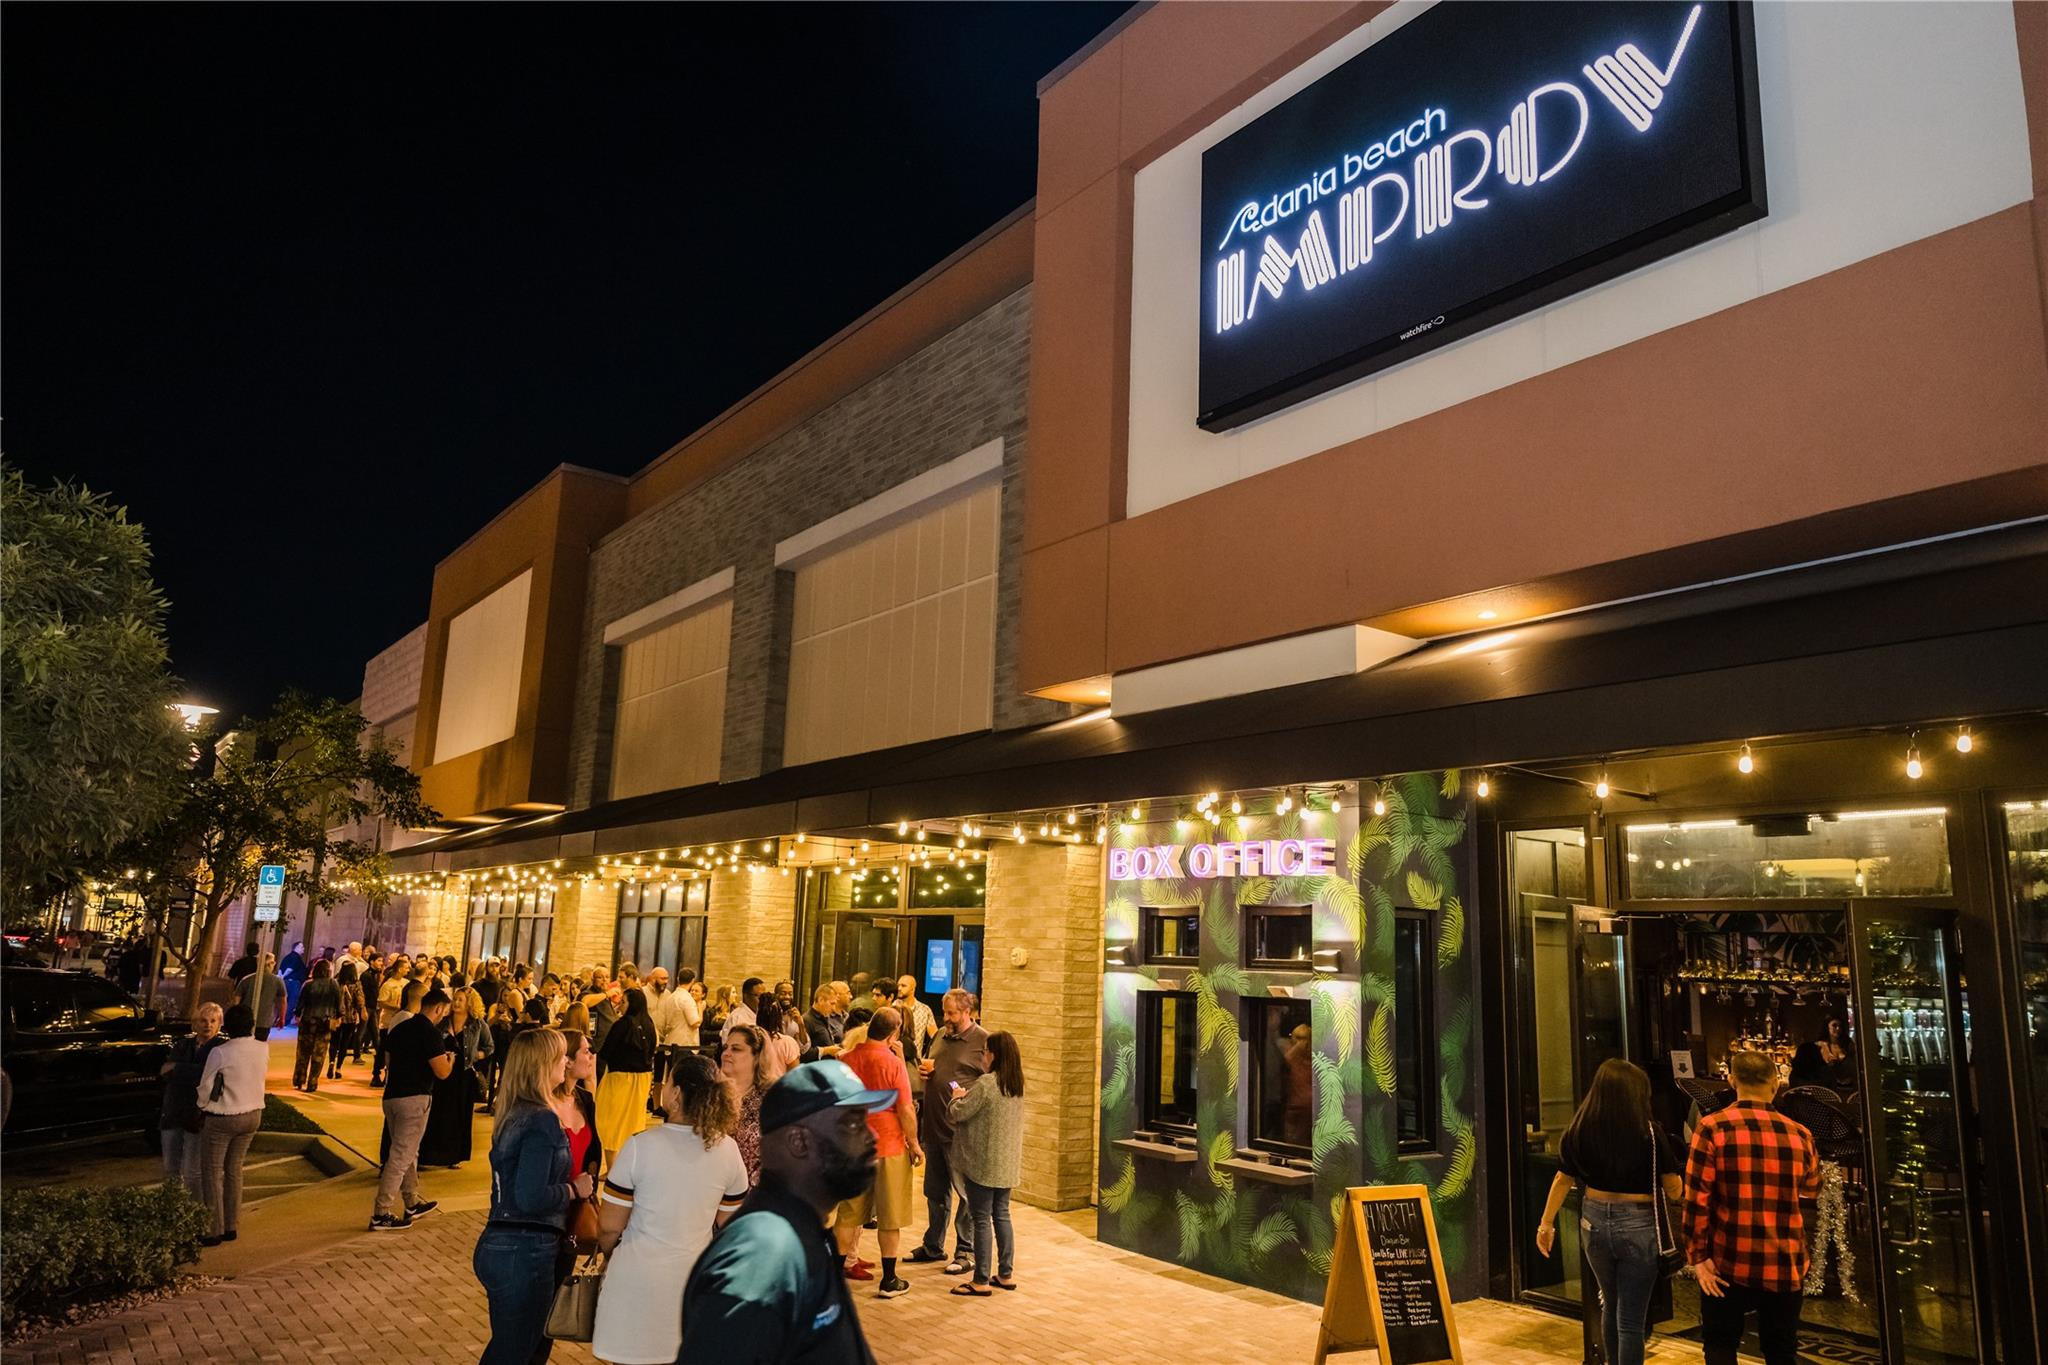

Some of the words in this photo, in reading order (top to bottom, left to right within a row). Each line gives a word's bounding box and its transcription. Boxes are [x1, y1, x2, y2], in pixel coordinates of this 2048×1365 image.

[1216, 3, 1702, 335] IMPROV
[1261, 167, 1336, 227] dania
[1343, 108, 1447, 184] beach
[1400, 323, 1432, 340] watchfire
[1109, 845, 1176, 880] BOX
[1188, 838, 1329, 879] OFFICE
[1376, 1203, 1417, 1231] NORTH
